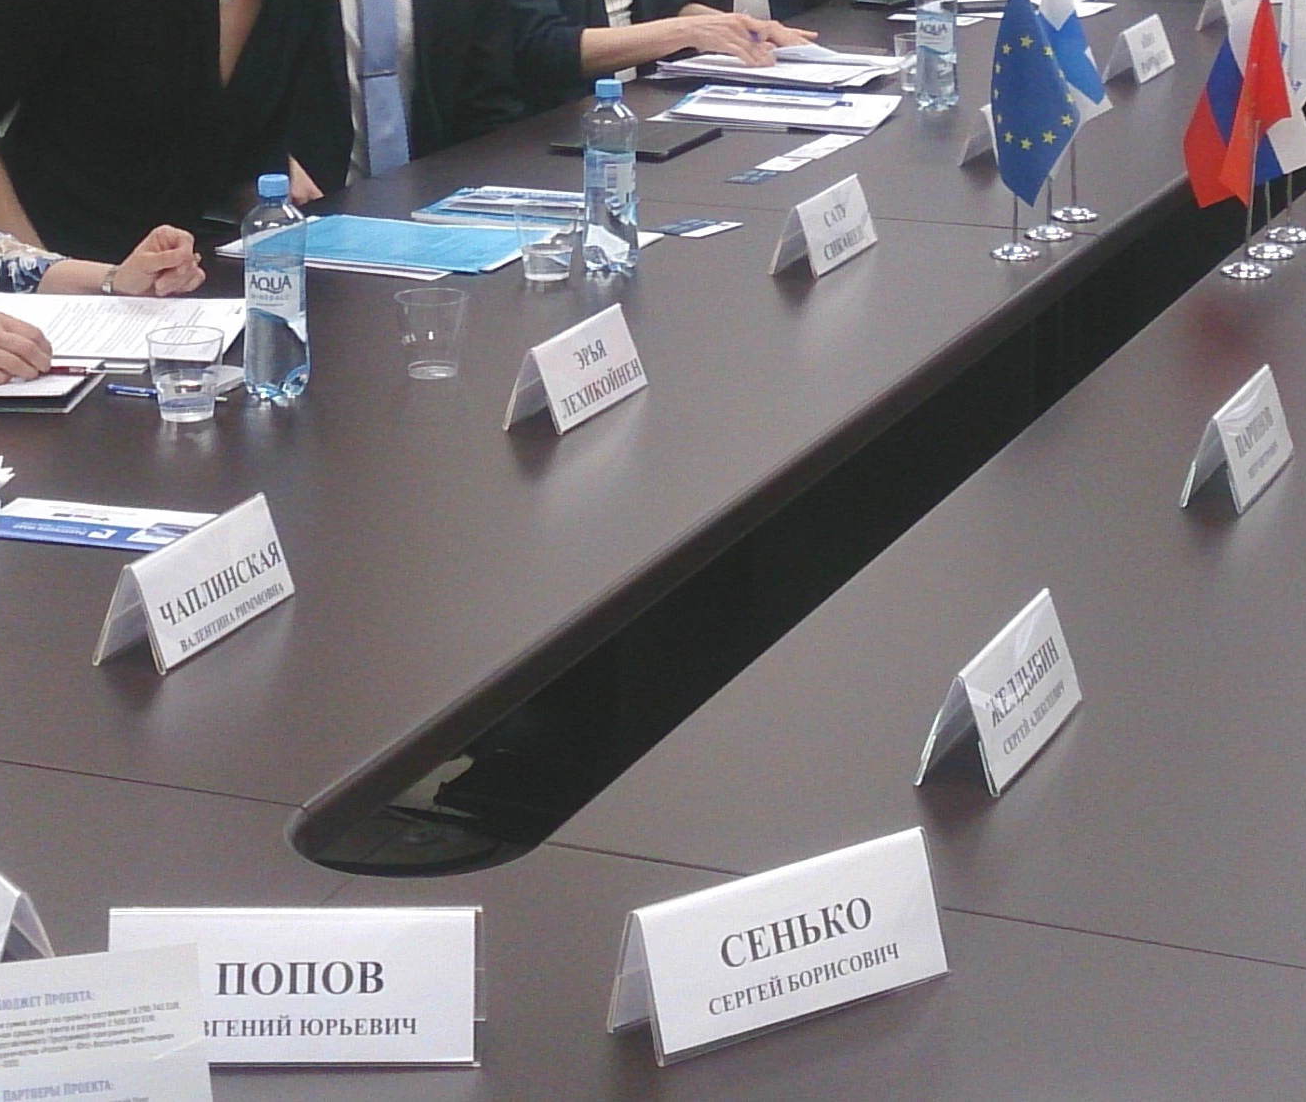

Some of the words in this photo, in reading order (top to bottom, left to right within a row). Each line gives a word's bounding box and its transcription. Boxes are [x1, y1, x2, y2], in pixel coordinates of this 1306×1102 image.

[919, 23, 948, 36] AQUA
[249, 274, 292, 294] AQUA
[573, 339, 608, 370] ЭРЬЯ
[559, 357, 643, 419] ЛЕХИКОЙНЕН
[159, 540, 282, 626] ЧАПЛИНСКАЯ
[180, 612, 235, 653] ВАЛЕНТИНА
[985, 635, 1060, 729] ЖЕЛДЫБИН
[1003, 717, 1031, 755] СЕРГЕЙ
[720, 896, 873, 970] СЕНЬКО
[214, 959, 385, 997] ПОПОВ
[708, 975, 784, 1017] СЕРГЕЙ
[788, 942, 900, 992] БОРИСОВИЧ
[204, 1014, 292, 1038] ВГЕНИЙ
[299, 1016, 418, 1038] ЮРЬЕВИЧ
